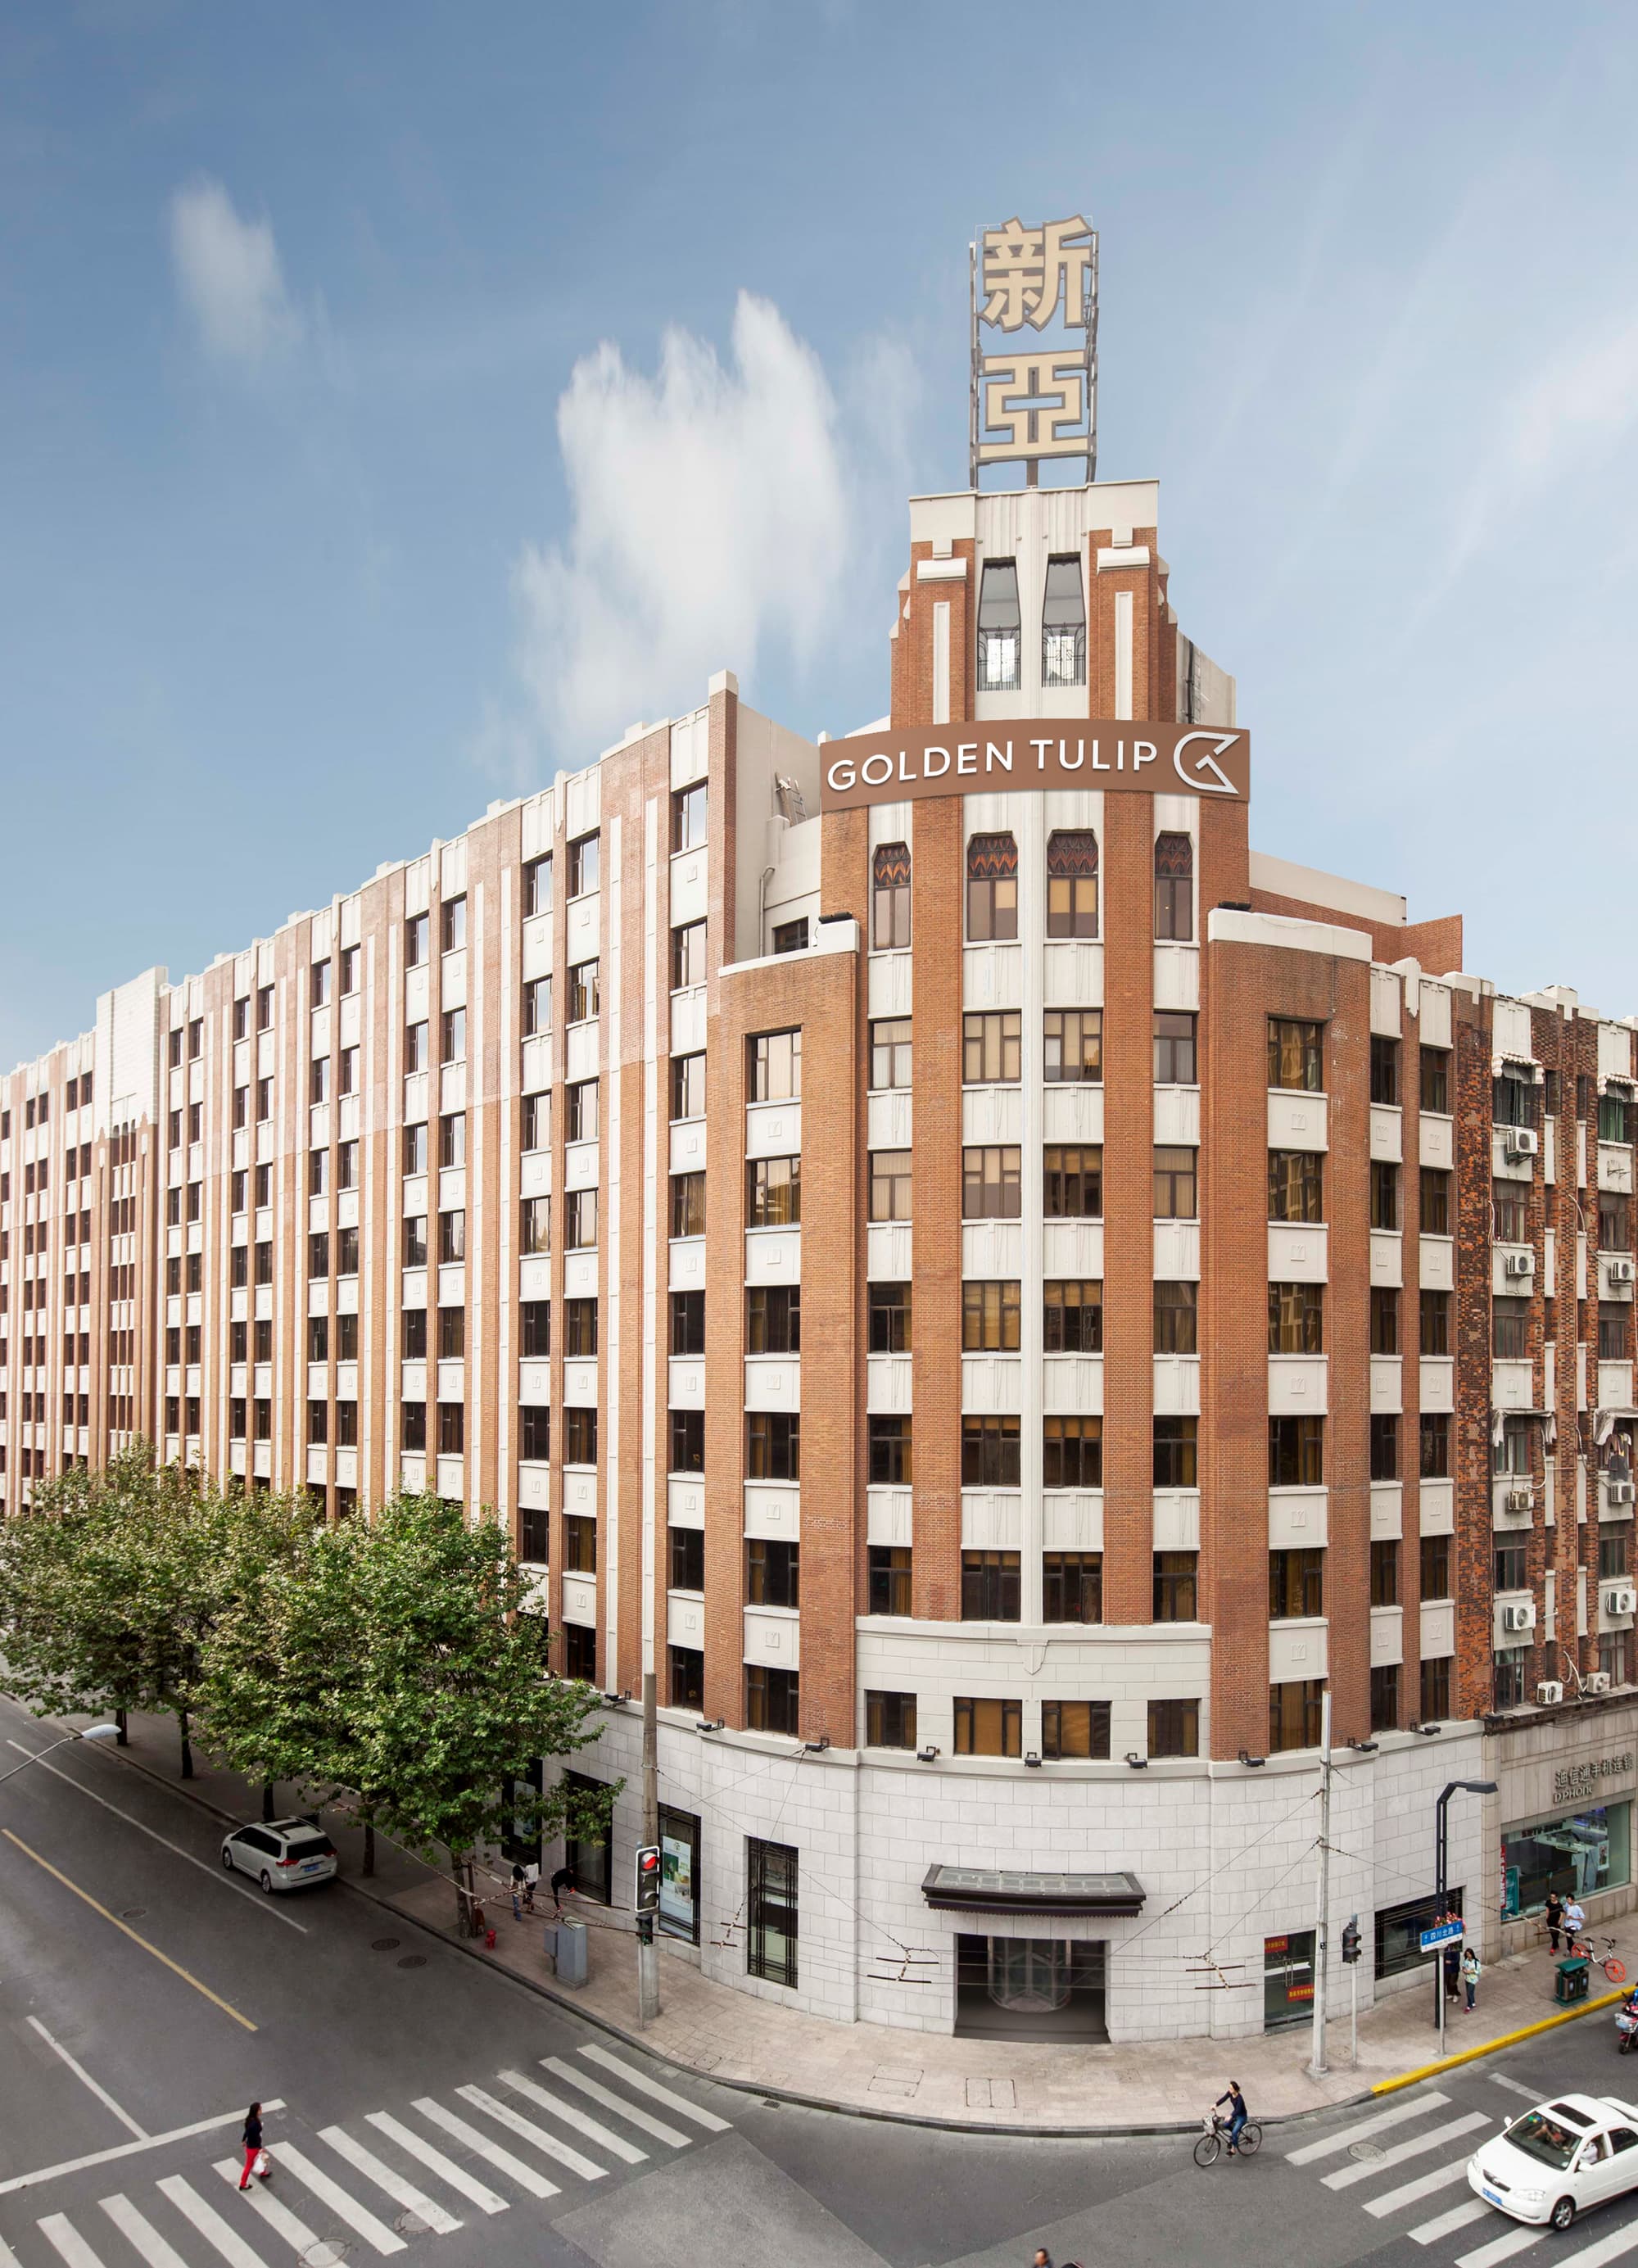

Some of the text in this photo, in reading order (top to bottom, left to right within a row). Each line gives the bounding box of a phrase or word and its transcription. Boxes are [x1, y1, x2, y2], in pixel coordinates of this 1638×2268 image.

[980, 216, 1093, 462] 新亞
[827, 739, 1158, 791] GOLDEN TULIP
[1555, 1753, 1633, 1788] 迪信通手机连锁
